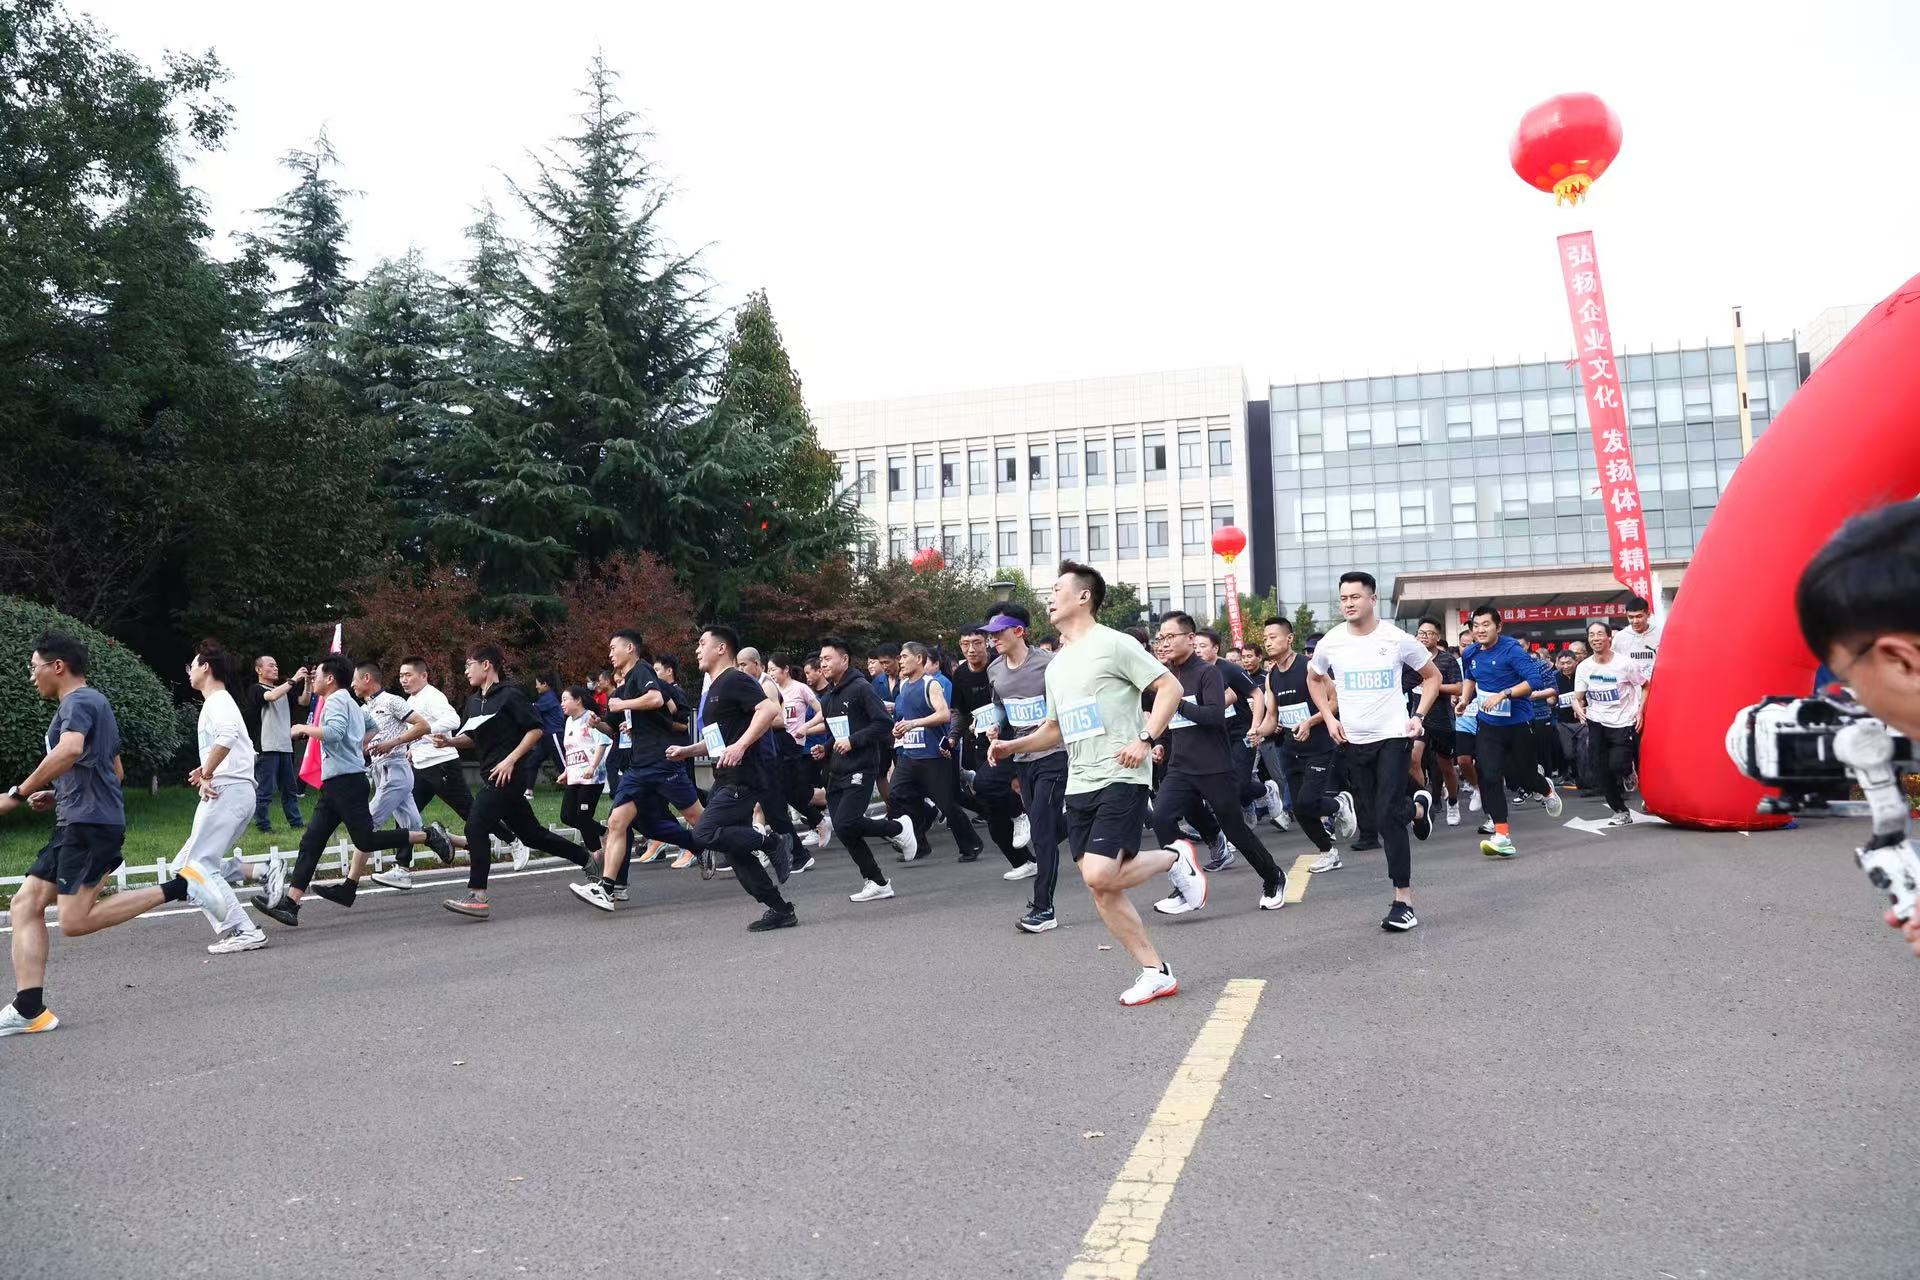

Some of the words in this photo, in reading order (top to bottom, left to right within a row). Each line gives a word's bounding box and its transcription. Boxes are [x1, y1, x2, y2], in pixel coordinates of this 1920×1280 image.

[1567, 246, 1618, 409] 弘扬企业文化
[1602, 429, 1650, 599] 发扬体育精神
[1499, 604, 1627, 620] 团第二十八届职工越野
[1630, 651, 1653, 660] PUMA
